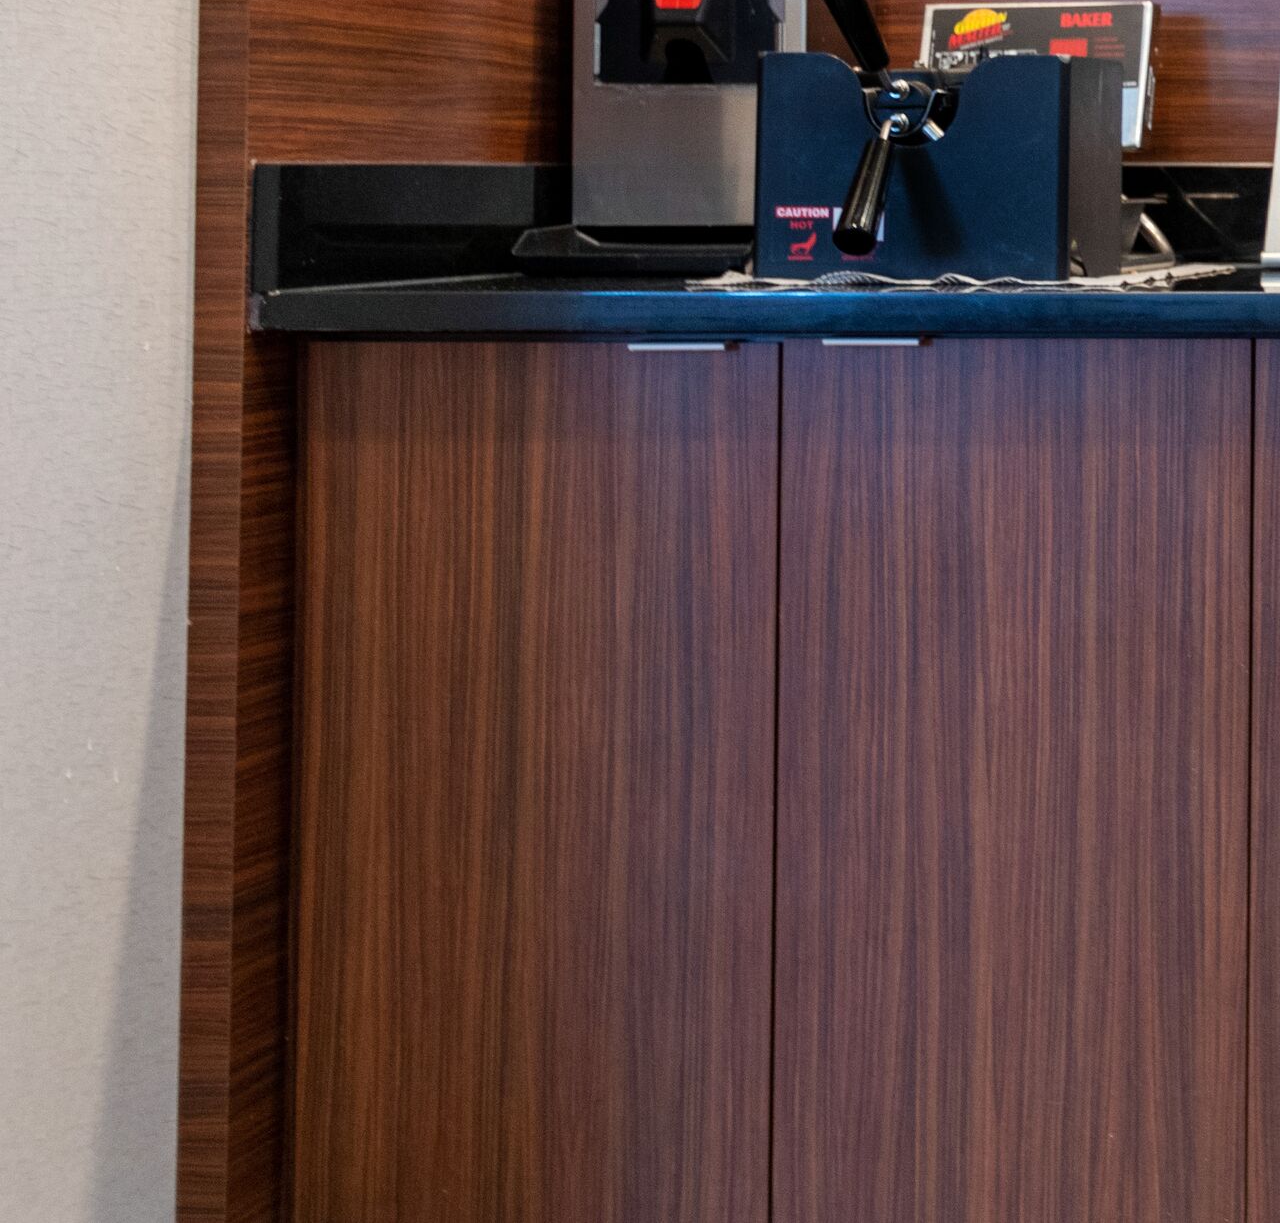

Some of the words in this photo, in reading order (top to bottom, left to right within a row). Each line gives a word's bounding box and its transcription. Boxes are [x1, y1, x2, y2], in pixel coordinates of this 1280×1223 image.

[1060, 12, 1113, 28] BAKER
[776, 207, 829, 218] CAUTION
[789, 220, 814, 230] HOT
